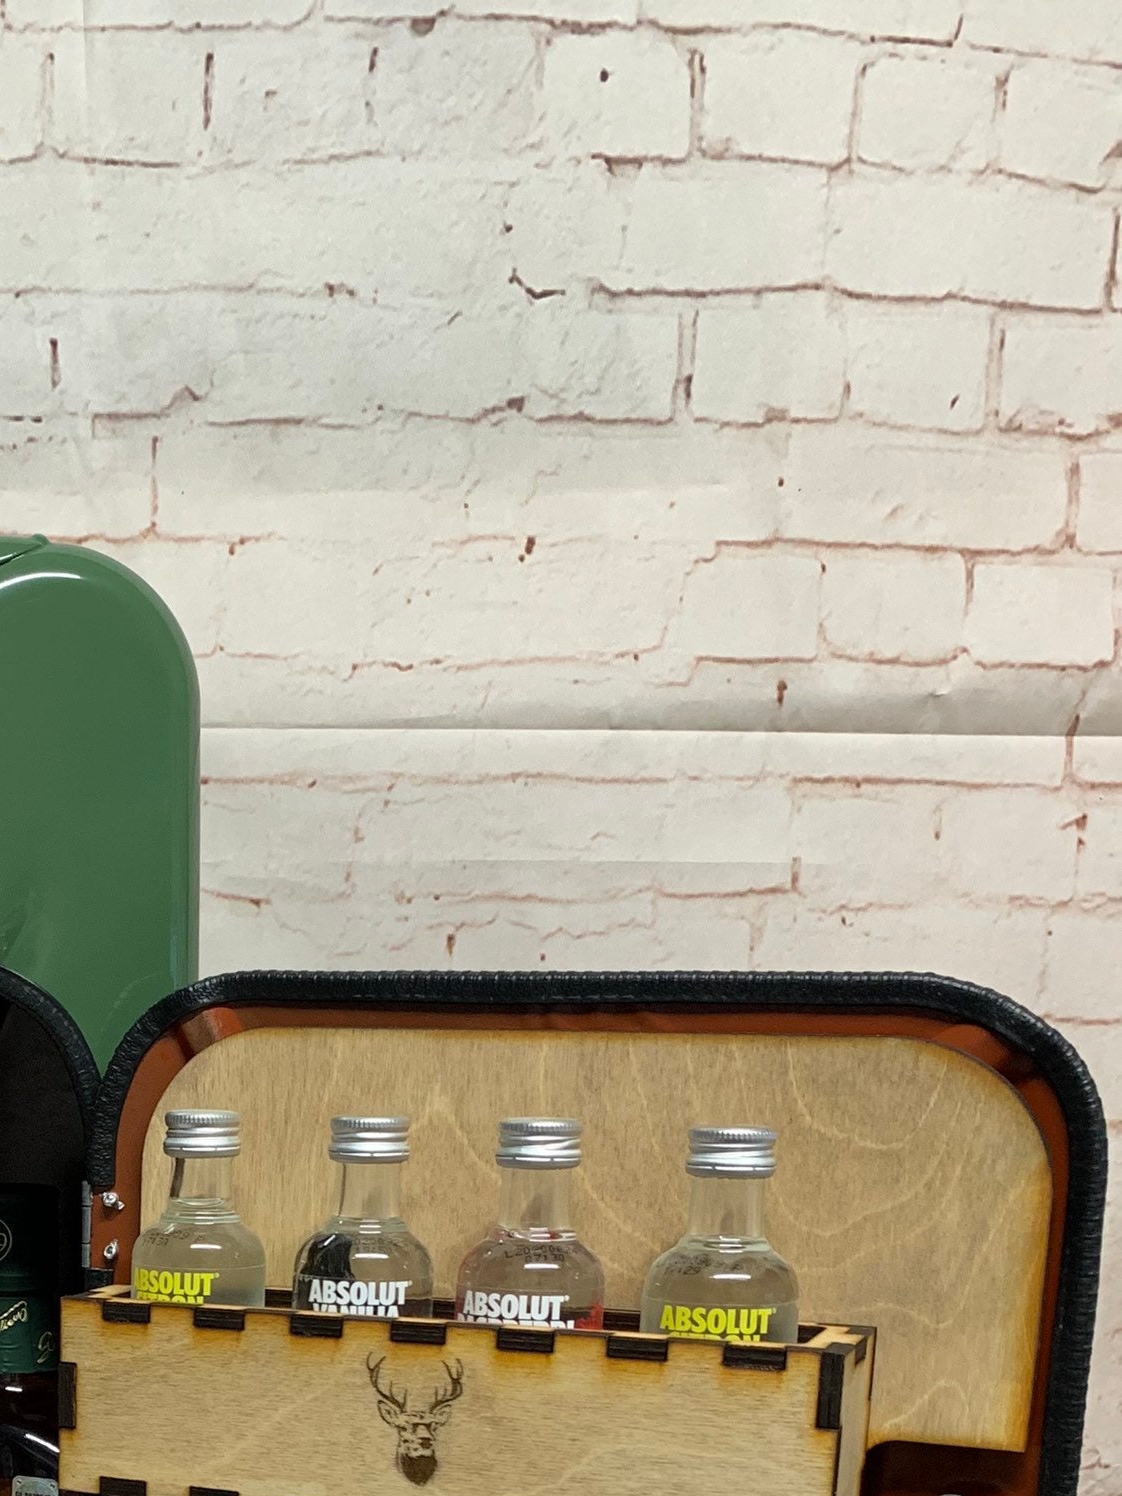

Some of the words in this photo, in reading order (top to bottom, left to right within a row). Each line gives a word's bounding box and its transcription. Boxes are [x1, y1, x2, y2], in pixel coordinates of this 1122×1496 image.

[134, 1267, 215, 1296] ABSOLUT
[308, 1279, 409, 1306] ABSOLUT
[463, 1290, 565, 1321] ABSOLUT
[659, 1304, 772, 1334] ABSOLUT
